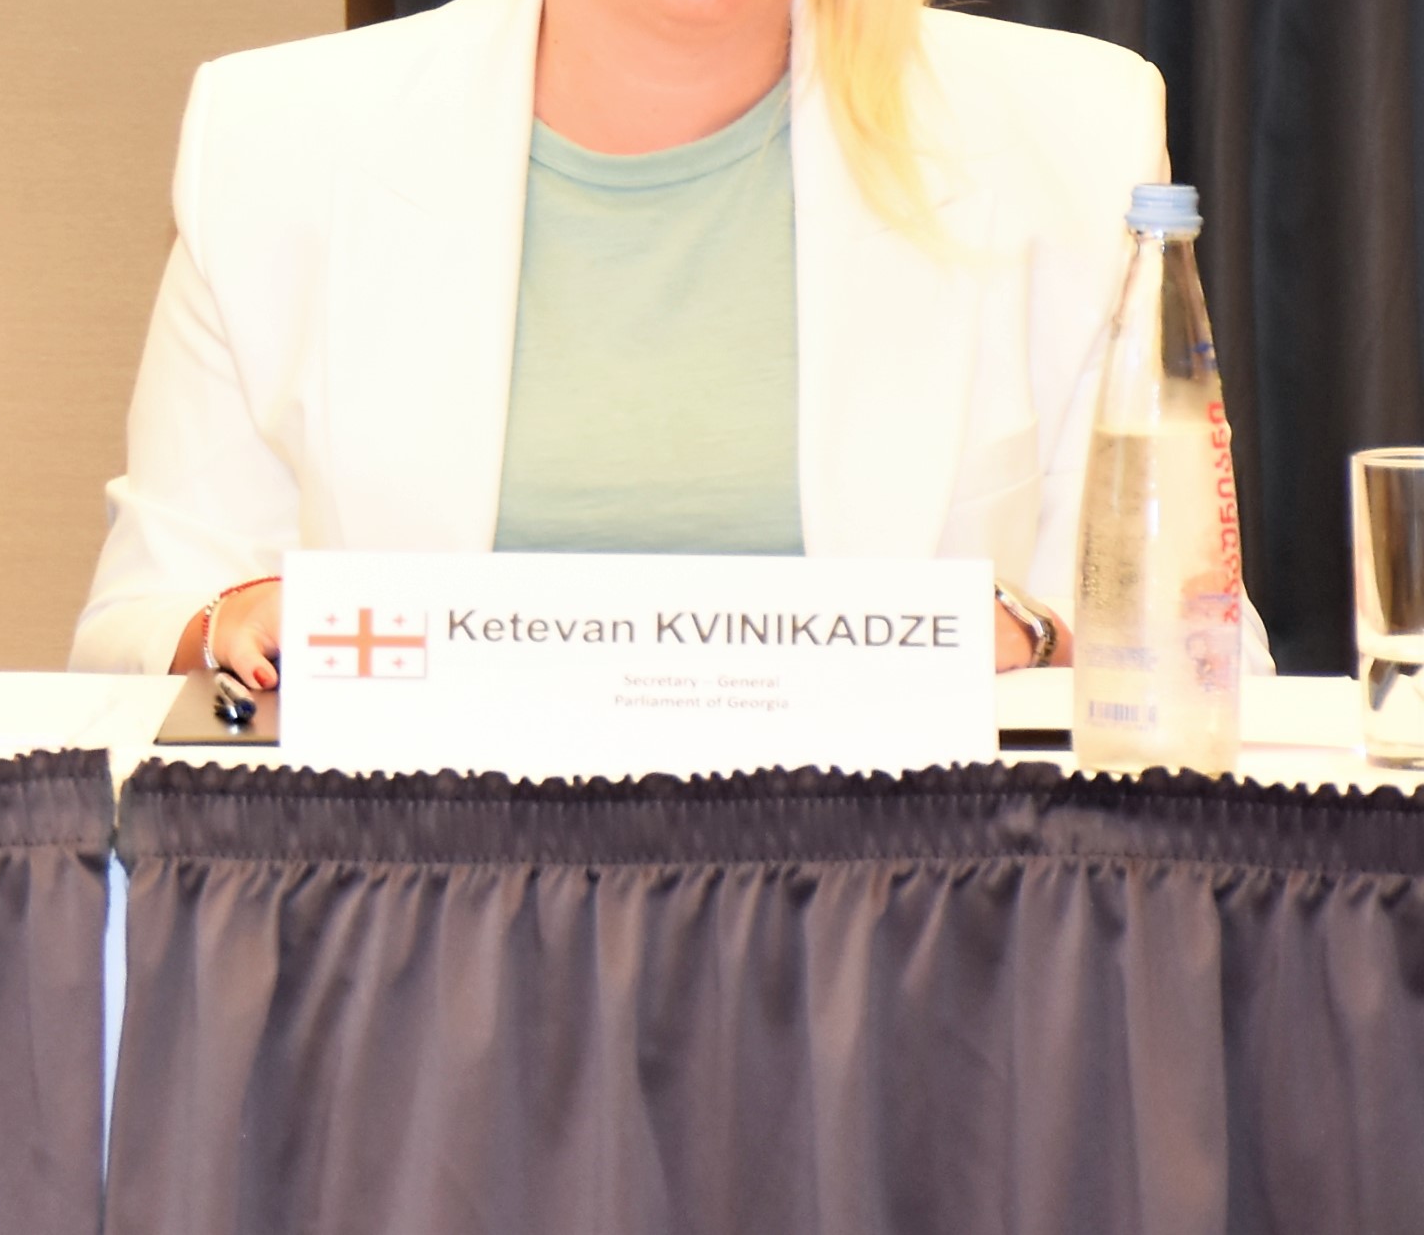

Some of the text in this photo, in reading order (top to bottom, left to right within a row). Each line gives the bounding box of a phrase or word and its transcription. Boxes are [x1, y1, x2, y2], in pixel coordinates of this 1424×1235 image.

[447, 609, 960, 648] Ketevan KVINIKADZE
[622, 673, 697, 689] Secretary
[717, 674, 780, 689] General
[614, 694, 790, 712] Parliament of Georgia
